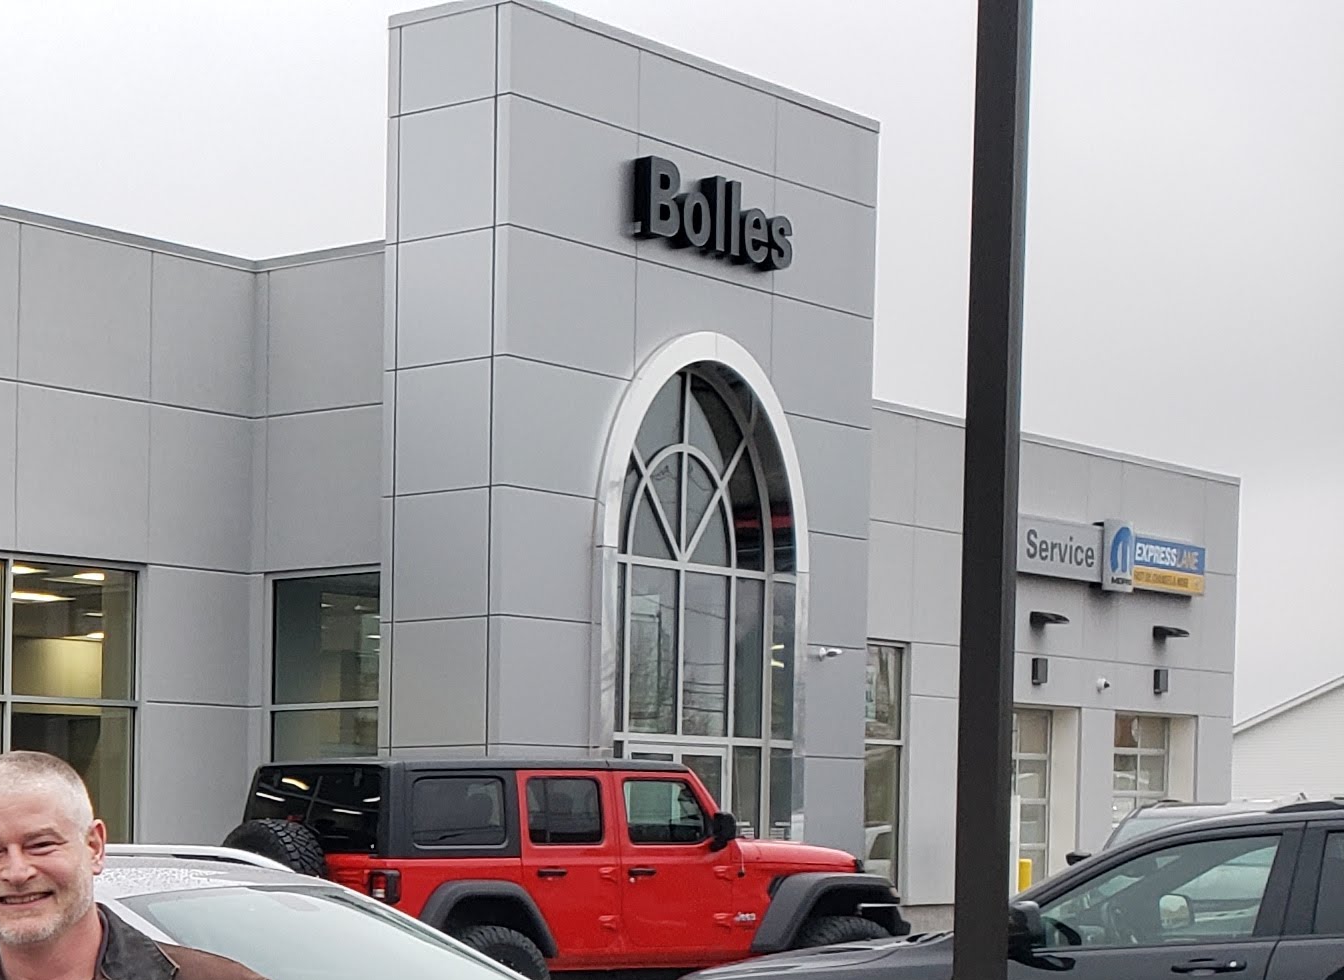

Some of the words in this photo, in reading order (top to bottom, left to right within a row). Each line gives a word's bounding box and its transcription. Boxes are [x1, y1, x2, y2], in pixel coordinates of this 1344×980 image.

[634, 155, 793, 271] Bolles
[1026, 528, 1095, 568] Service
[1134, 542, 1177, 567] EXPRESS
